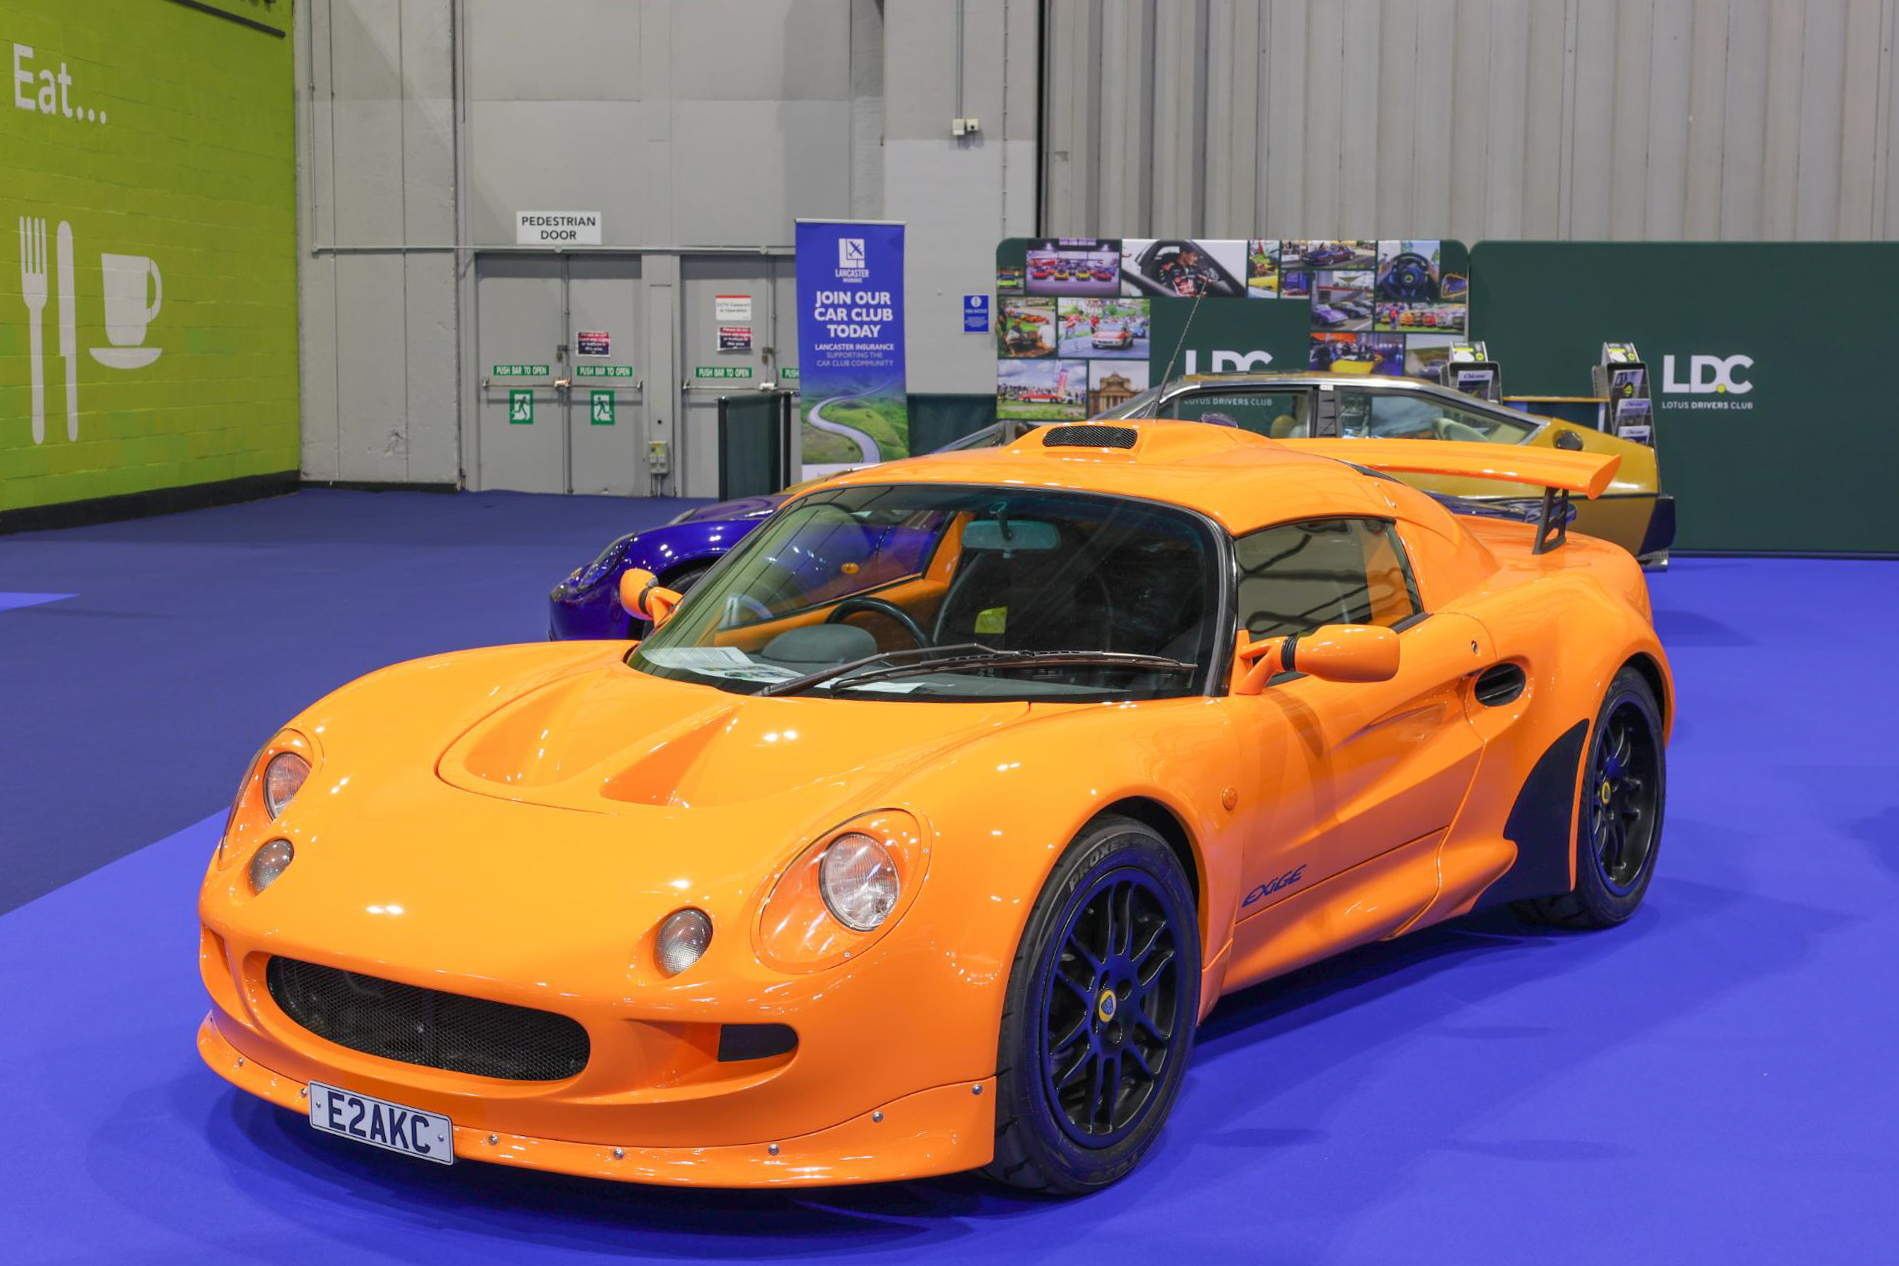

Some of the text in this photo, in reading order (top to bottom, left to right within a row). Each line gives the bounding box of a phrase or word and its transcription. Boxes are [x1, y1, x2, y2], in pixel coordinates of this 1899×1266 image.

[521, 216, 596, 226] PEDESTRIAN
[540, 230, 577, 240] DOOR
[835, 269, 869, 277] LANCASTER
[815, 291, 891, 307] JOIN OUR
[814, 308, 893, 321] CAR CLUB
[827, 324, 881, 338] TODAY
[815, 343, 894, 351] LANCASTER INSURANCE
[826, 351, 869, 359] SUPPORTING
[816, 359, 831, 367] CAR
[832, 359, 850, 367] CLUB
[496, 366, 547, 375] PUSH BAR TO OPEN
[579, 367, 630, 376] PUSH BAR TO OPEN
[698, 368, 749, 377] PUSH BAR TO OPEN
[1212, 397, 1248, 406] DRIVERS
[1250, 398, 1273, 406] CLUB
[1662, 401, 1754, 409] LOTUS DRIVERS CLUB
[327, 1090, 431, 1154] E2AKC
